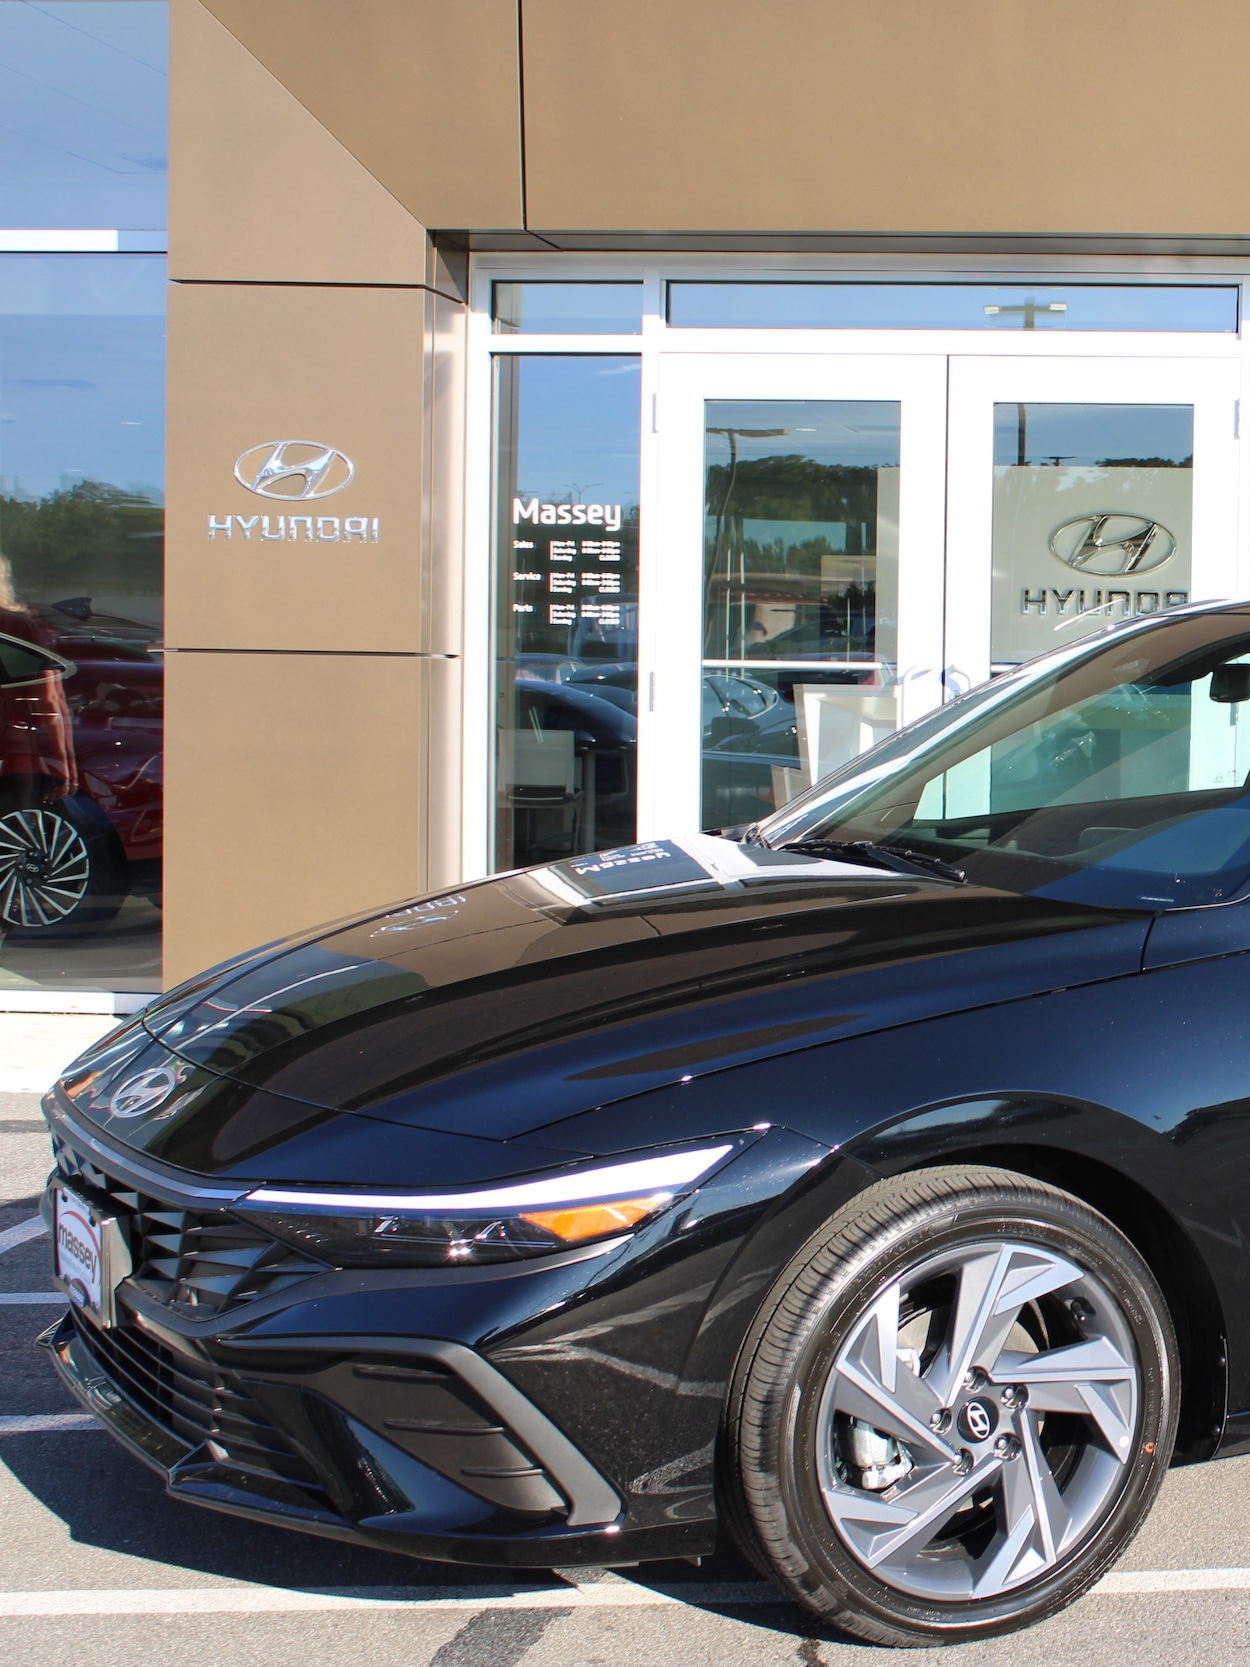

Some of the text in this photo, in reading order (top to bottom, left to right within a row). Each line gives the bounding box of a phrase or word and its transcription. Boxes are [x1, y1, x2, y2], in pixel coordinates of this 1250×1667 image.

[208, 514, 380, 544] HYUNDAI
[512, 498, 621, 531] Massey
[513, 572, 542, 580] Service
[512, 604, 533, 612] Parts
[58, 1222, 97, 1284] massey
